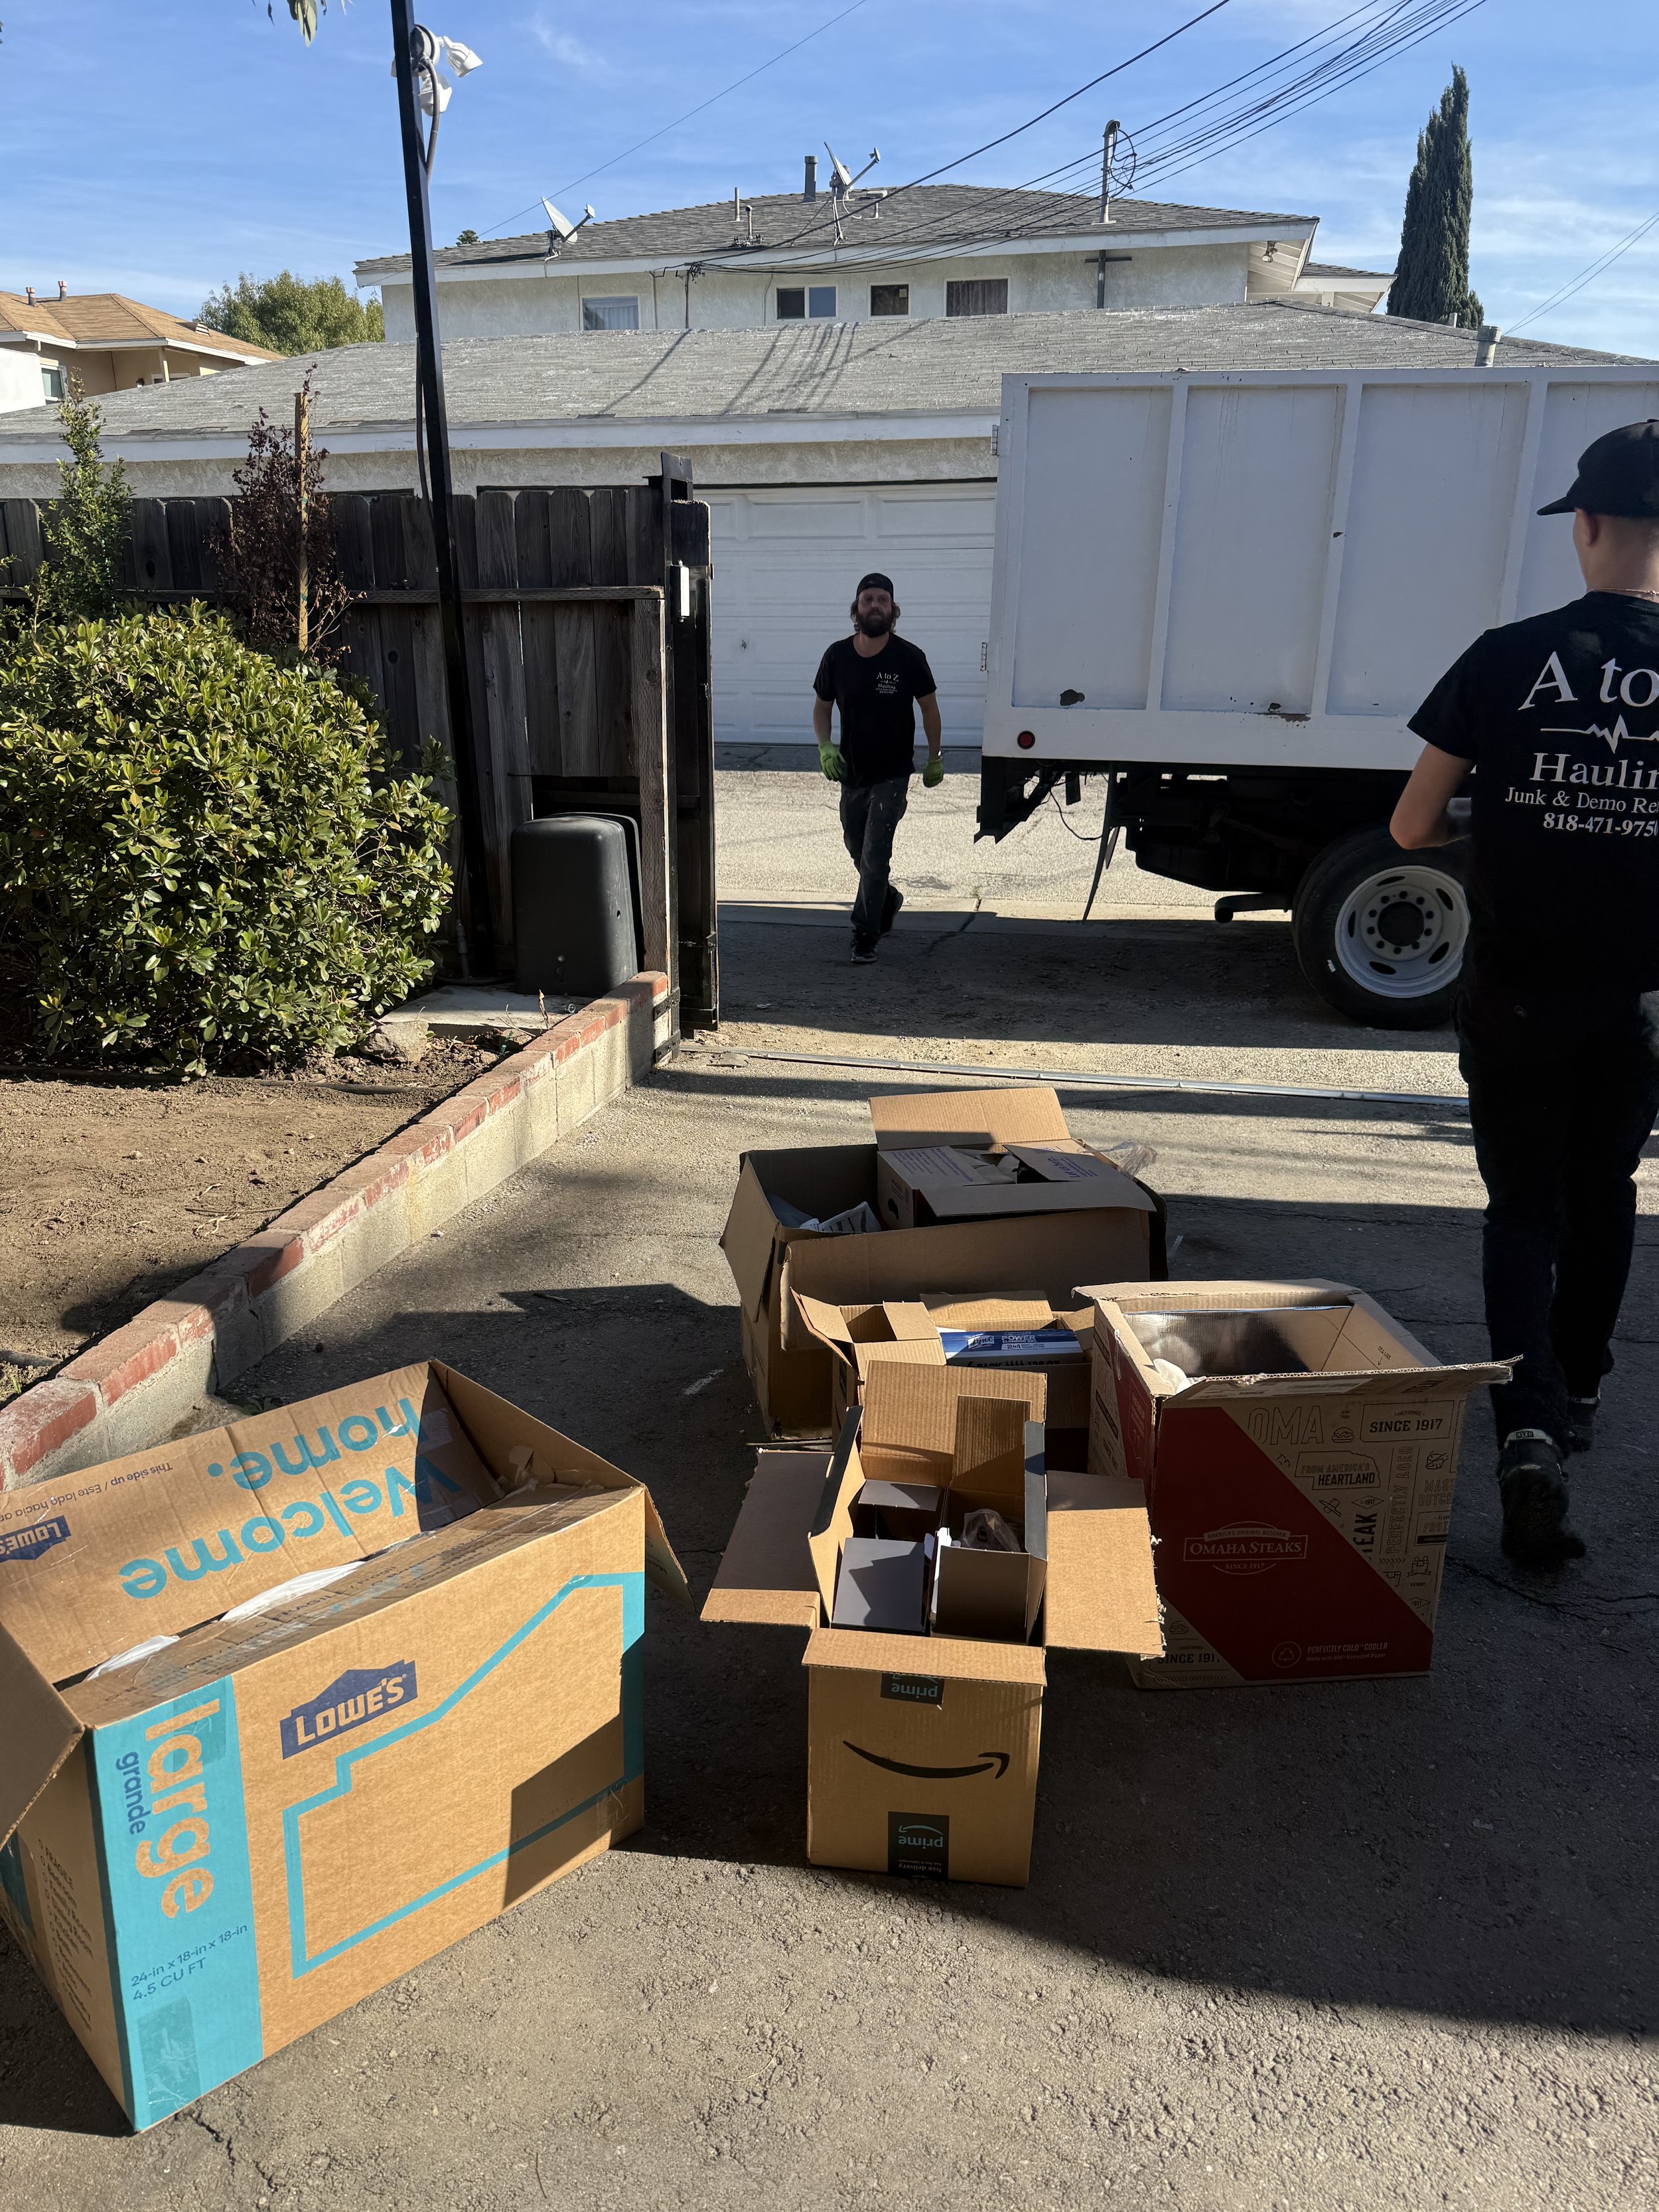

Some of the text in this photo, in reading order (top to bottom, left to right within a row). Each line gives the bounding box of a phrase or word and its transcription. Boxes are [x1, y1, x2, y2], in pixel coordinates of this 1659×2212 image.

[1518, 651, 1659, 710] A to
[1506, 787, 1659, 814] Junk & Demo Re
[970, 1335, 994, 1347] Lysol
[1370, 1418, 1443, 1434] SINCE 1917
[208, 1398, 429, 1490] home.
[150, 1463, 173, 1474] This
[1301, 1462, 1371, 1473] FROM AMERICA'S
[1396, 1446, 1413, 1479] AGED
[111, 1476, 125, 1486] up
[127, 1468, 149, 1481] side
[1318, 1472, 1376, 1486] HEARTLAND
[78, 1484, 102, 1497] Este
[50, 1494, 77, 1506] lado
[15, 1501, 48, 1518] hacia
[118, 1455, 461, 1599] Welcome
[1386, 1485, 1408, 1554] PERFECTLY
[1207, 1530, 1236, 1539] AMERICA'S
[1262, 1530, 1287, 1538] BUTCHER
[1190, 1541, 1302, 1556] OMAHA STEAKS
[1307, 1645, 1342, 1654] PERFECTLY
[1364, 1642, 1389, 1651] COOLER
[1198, 1653, 1220, 1663] 191
[891, 1683, 938, 1699] prime
[296, 1676, 405, 1746] LOWE'S
[116, 1751, 152, 1836] grande
[135, 1699, 220, 1919] large
[898, 1836, 944, 1850] prime
[131, 1923, 248, 1987] 24-in x 18-in x 18-in
[133, 1957, 207, 2001] 4.5 CU FT
